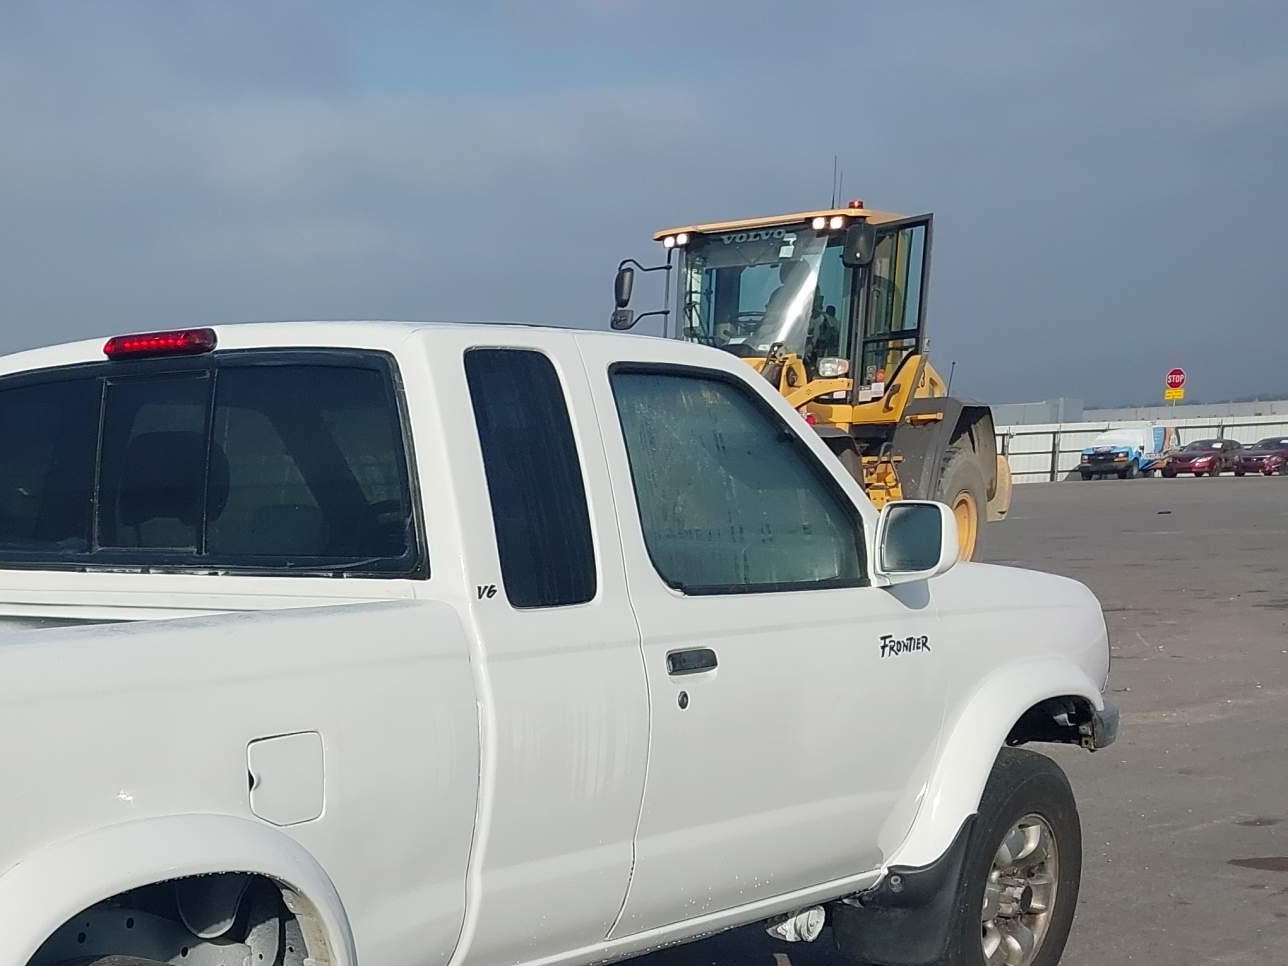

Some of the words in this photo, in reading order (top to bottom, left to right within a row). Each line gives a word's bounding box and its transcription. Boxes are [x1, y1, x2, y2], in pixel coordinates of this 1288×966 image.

[720, 229, 786, 244] VOLVO
[1167, 374, 1185, 383] STOP
[477, 584, 498, 600] V6
[879, 634, 931, 658] FRONTIER
